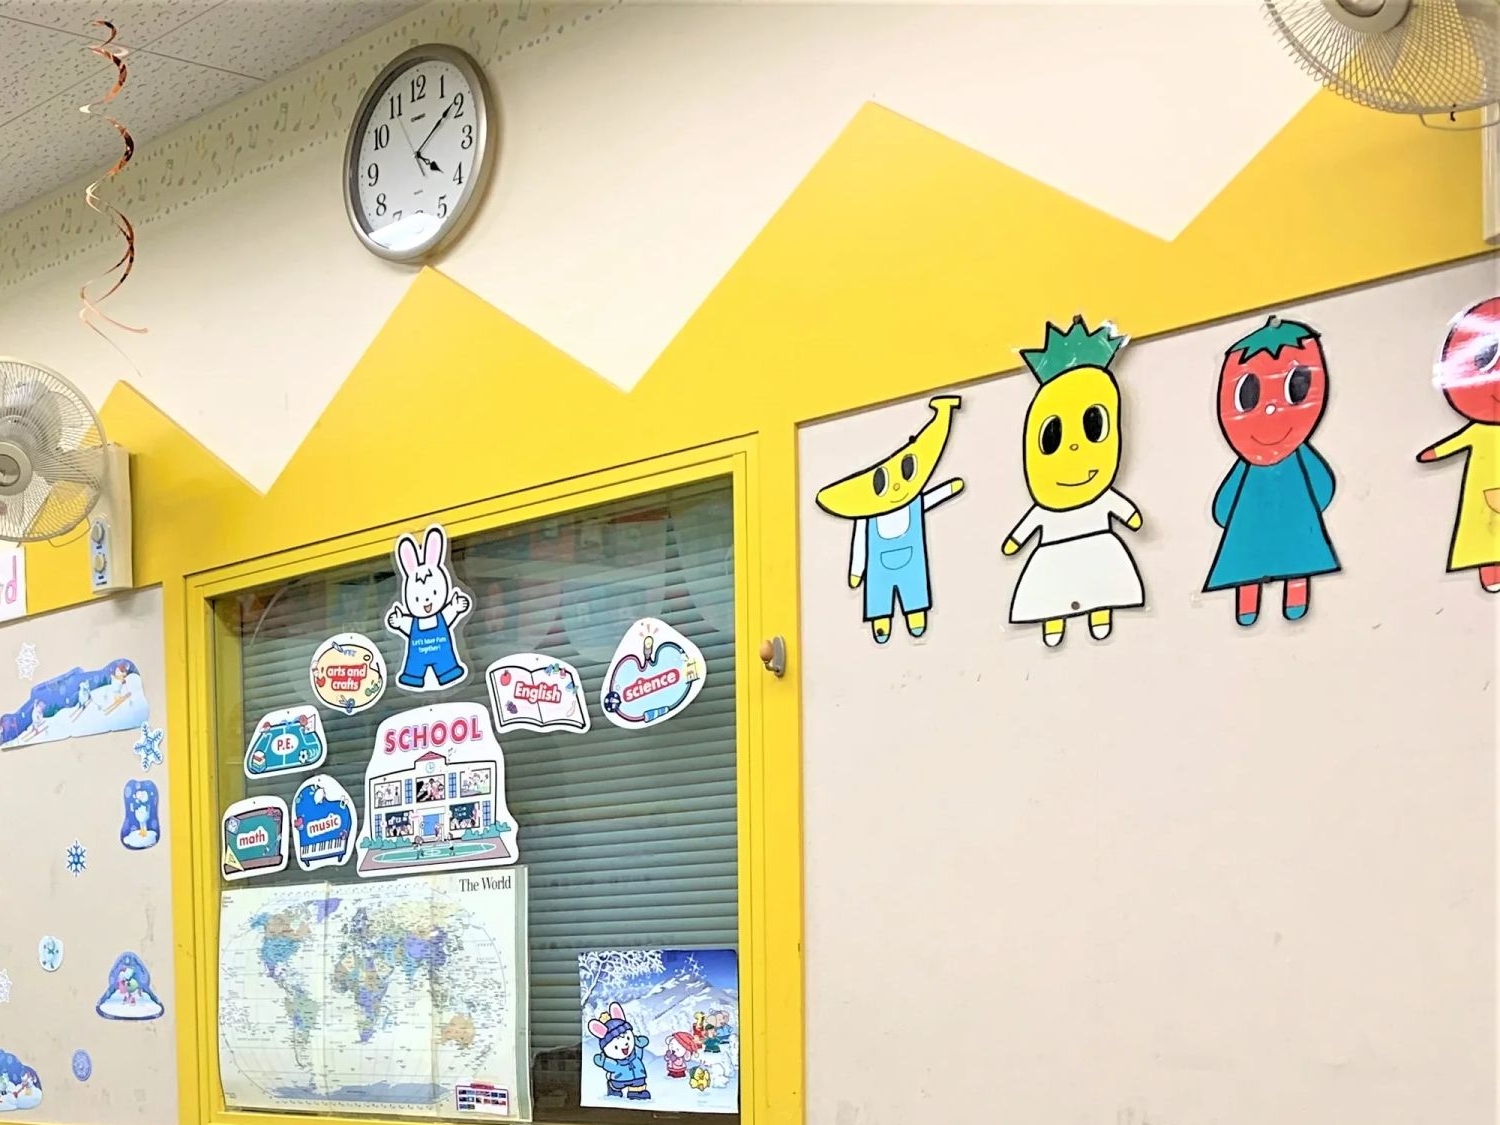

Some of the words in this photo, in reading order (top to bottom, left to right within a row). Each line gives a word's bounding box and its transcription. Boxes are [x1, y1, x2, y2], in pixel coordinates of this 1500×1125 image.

[410, 74, 426, 103] 12
[439, 74, 445, 99] 1
[389, 93, 403, 120] 11
[453, 93, 465, 118] 2
[373, 124, 390, 150] 10
[461, 124, 473, 149] 3
[367, 163, 379, 186] 9
[452, 161, 464, 185] 4
[376, 193, 387, 216] 8
[437, 195, 448, 218] 5
[328, 667, 346, 677] arts
[347, 665, 366, 677] and
[332, 678, 359, 690] crafts
[515, 683, 561, 703] English
[626, 671, 677, 701] science
[277, 738, 294, 751] P.E.
[384, 717, 482, 754] SCHOOL
[309, 817, 341, 835] music
[239, 831, 266, 846] math
[459, 878, 480, 892] The
[482, 875, 512, 891] World
